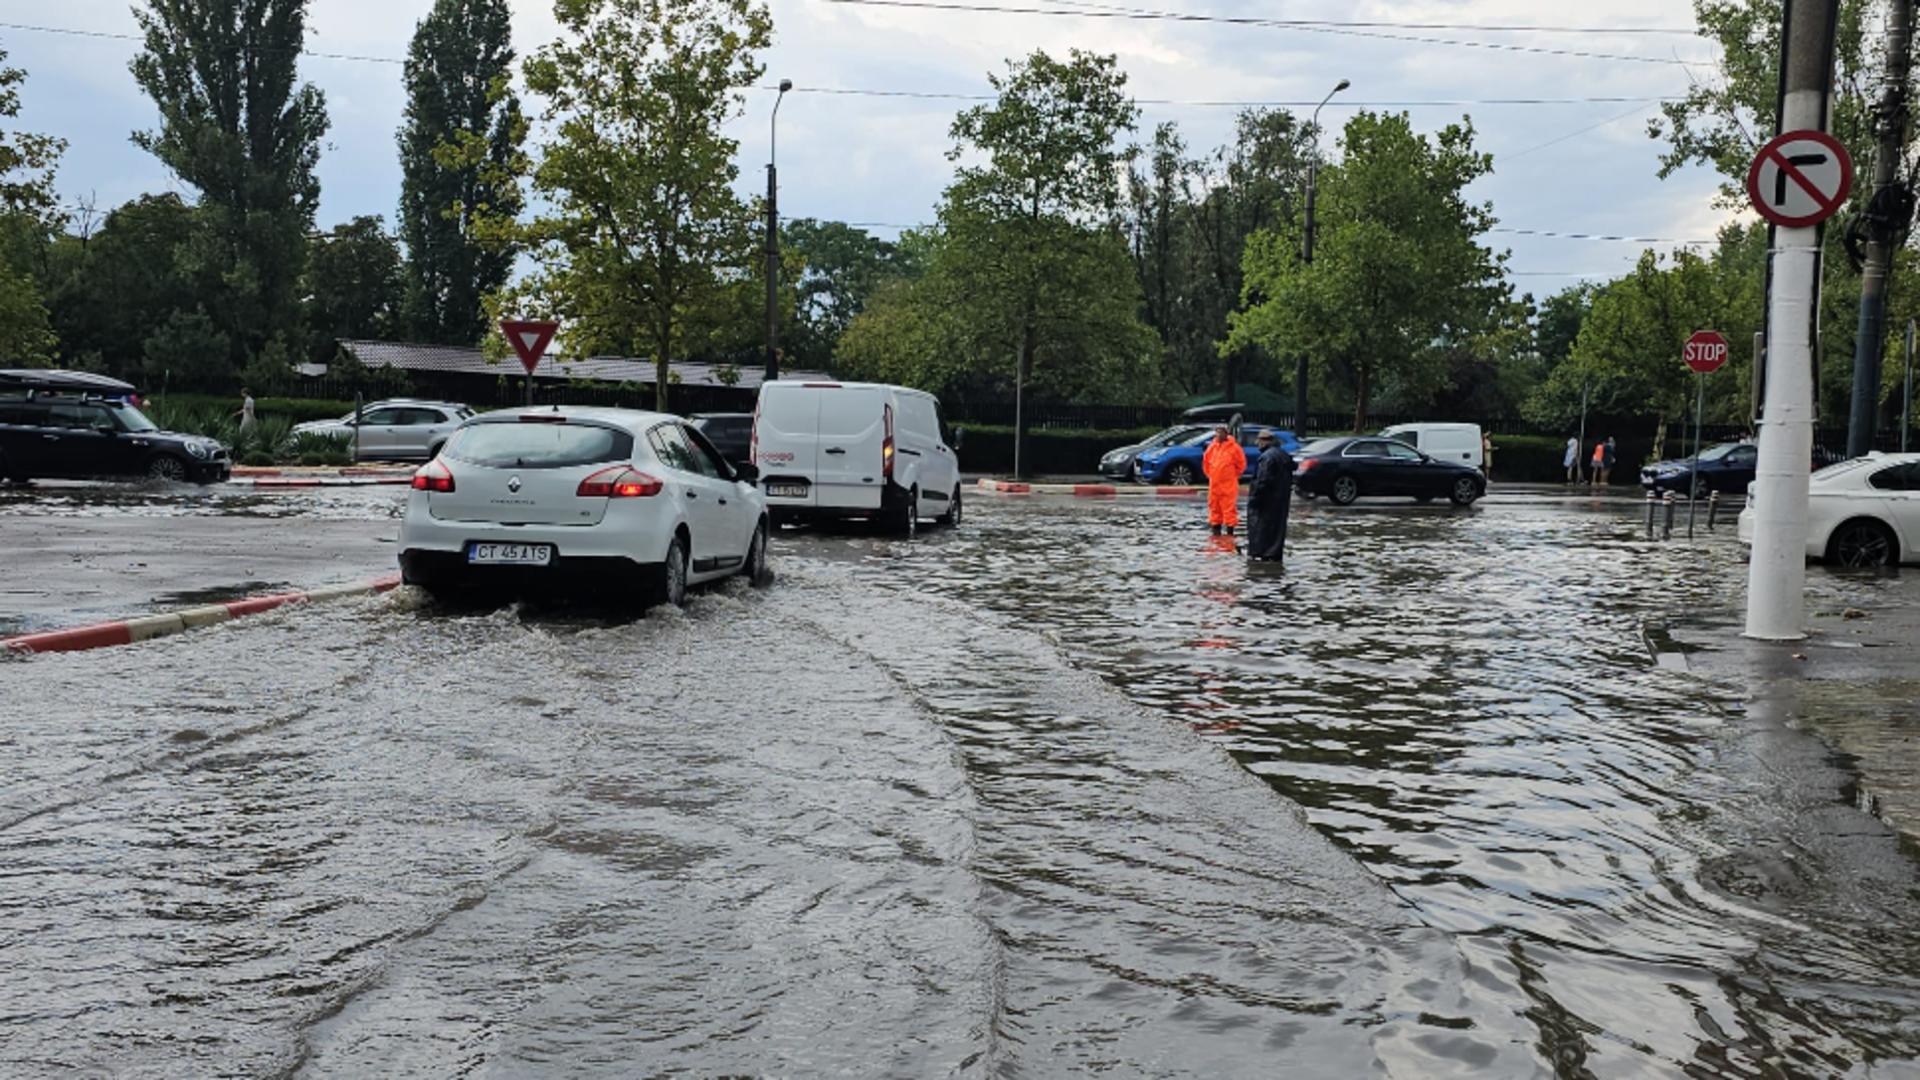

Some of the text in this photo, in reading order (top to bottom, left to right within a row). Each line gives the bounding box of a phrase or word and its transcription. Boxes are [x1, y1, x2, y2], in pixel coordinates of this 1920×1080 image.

[1686, 342, 1726, 361] STOP
[479, 545, 497, 559] CT
[501, 545, 518, 559] 45
